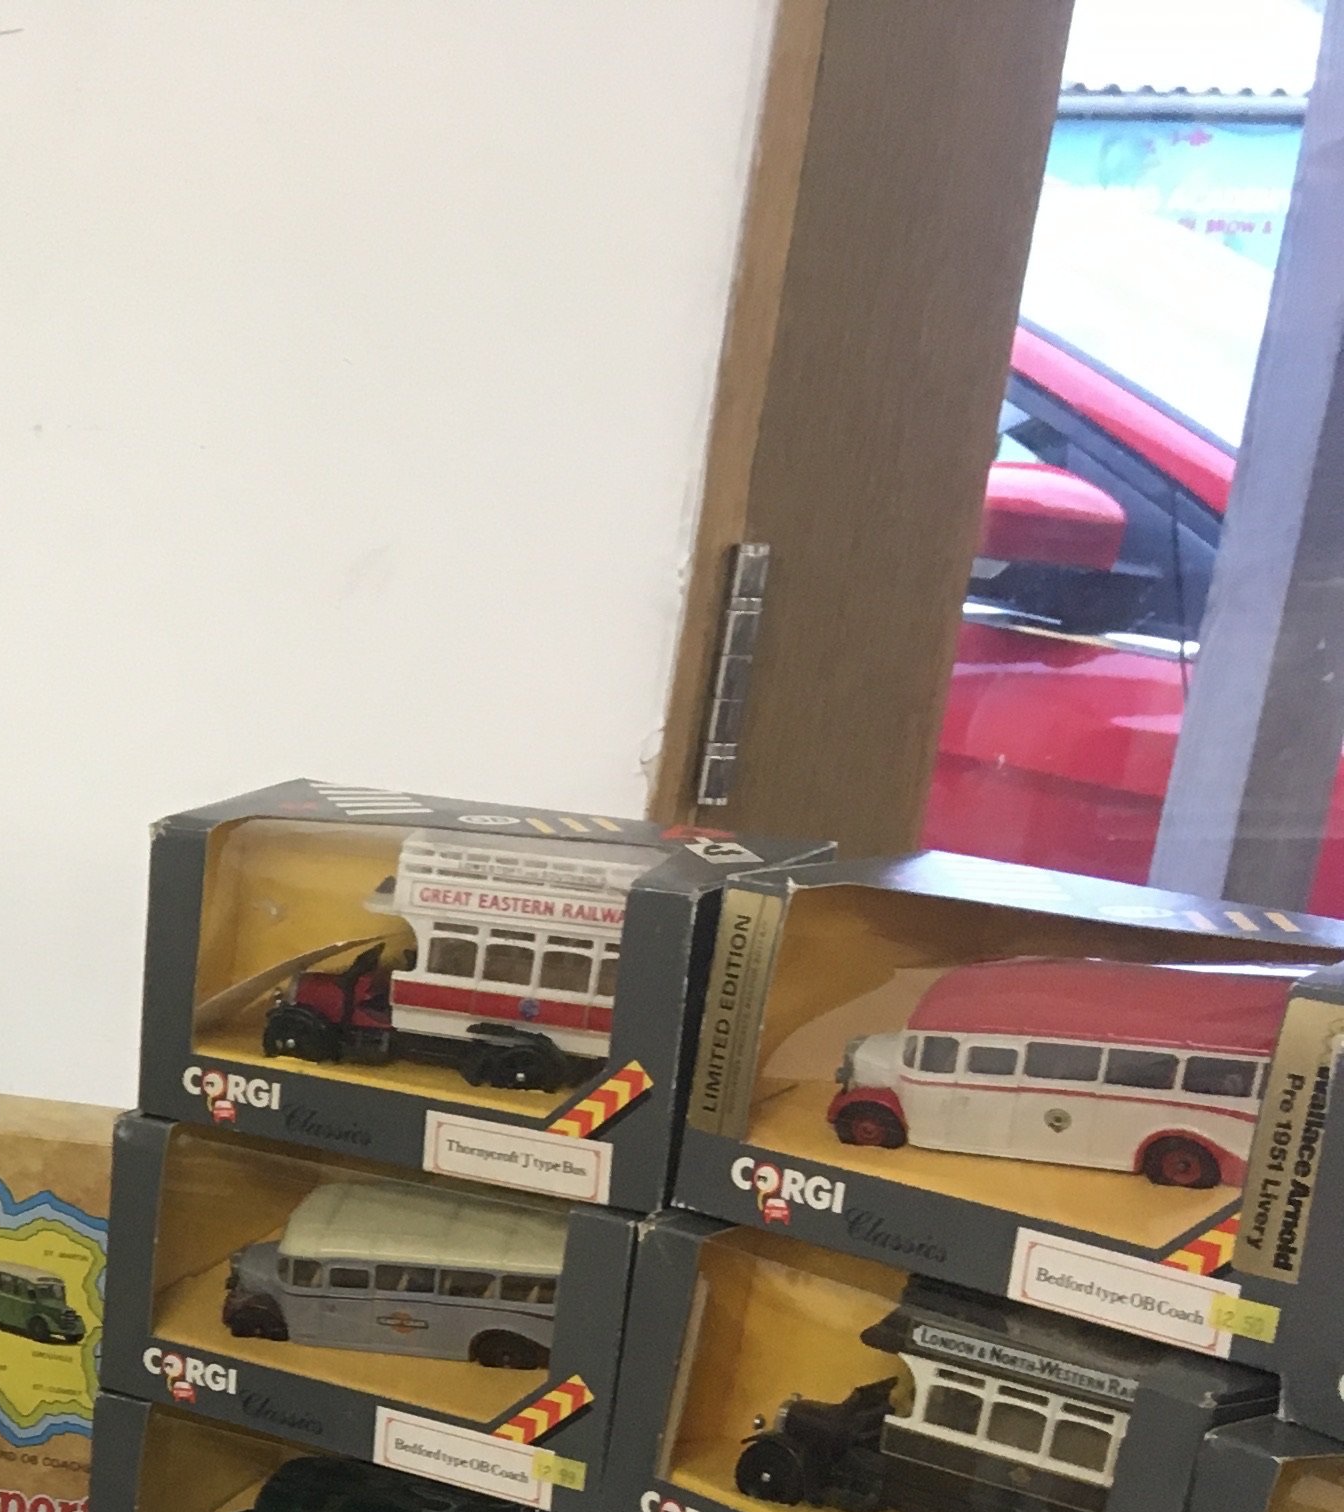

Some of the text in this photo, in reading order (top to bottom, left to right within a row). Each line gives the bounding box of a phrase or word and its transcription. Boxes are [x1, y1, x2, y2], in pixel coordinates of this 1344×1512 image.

[419, 886, 472, 907] GREAT
[477, 893, 555, 917] EASTERN
[702, 1017, 730, 1113] LIMITED
[720, 913, 752, 1011] EDITION
[182, 1066, 282, 1111] CORGI
[562, 1160, 587, 1177] Bus
[1246, 1073, 1306, 1251] Pre 1951 Livery
[730, 1156, 948, 1265] CORGI Classics
[1272, 1178, 1311, 1272] Arnold
[1035, 1267, 1205, 1326] Bedford type OB Coach
[142, 1347, 238, 1394] CORGI
[394, 1438, 441, 1464] Bedford
[490, 1463, 529, 1486] Coach
